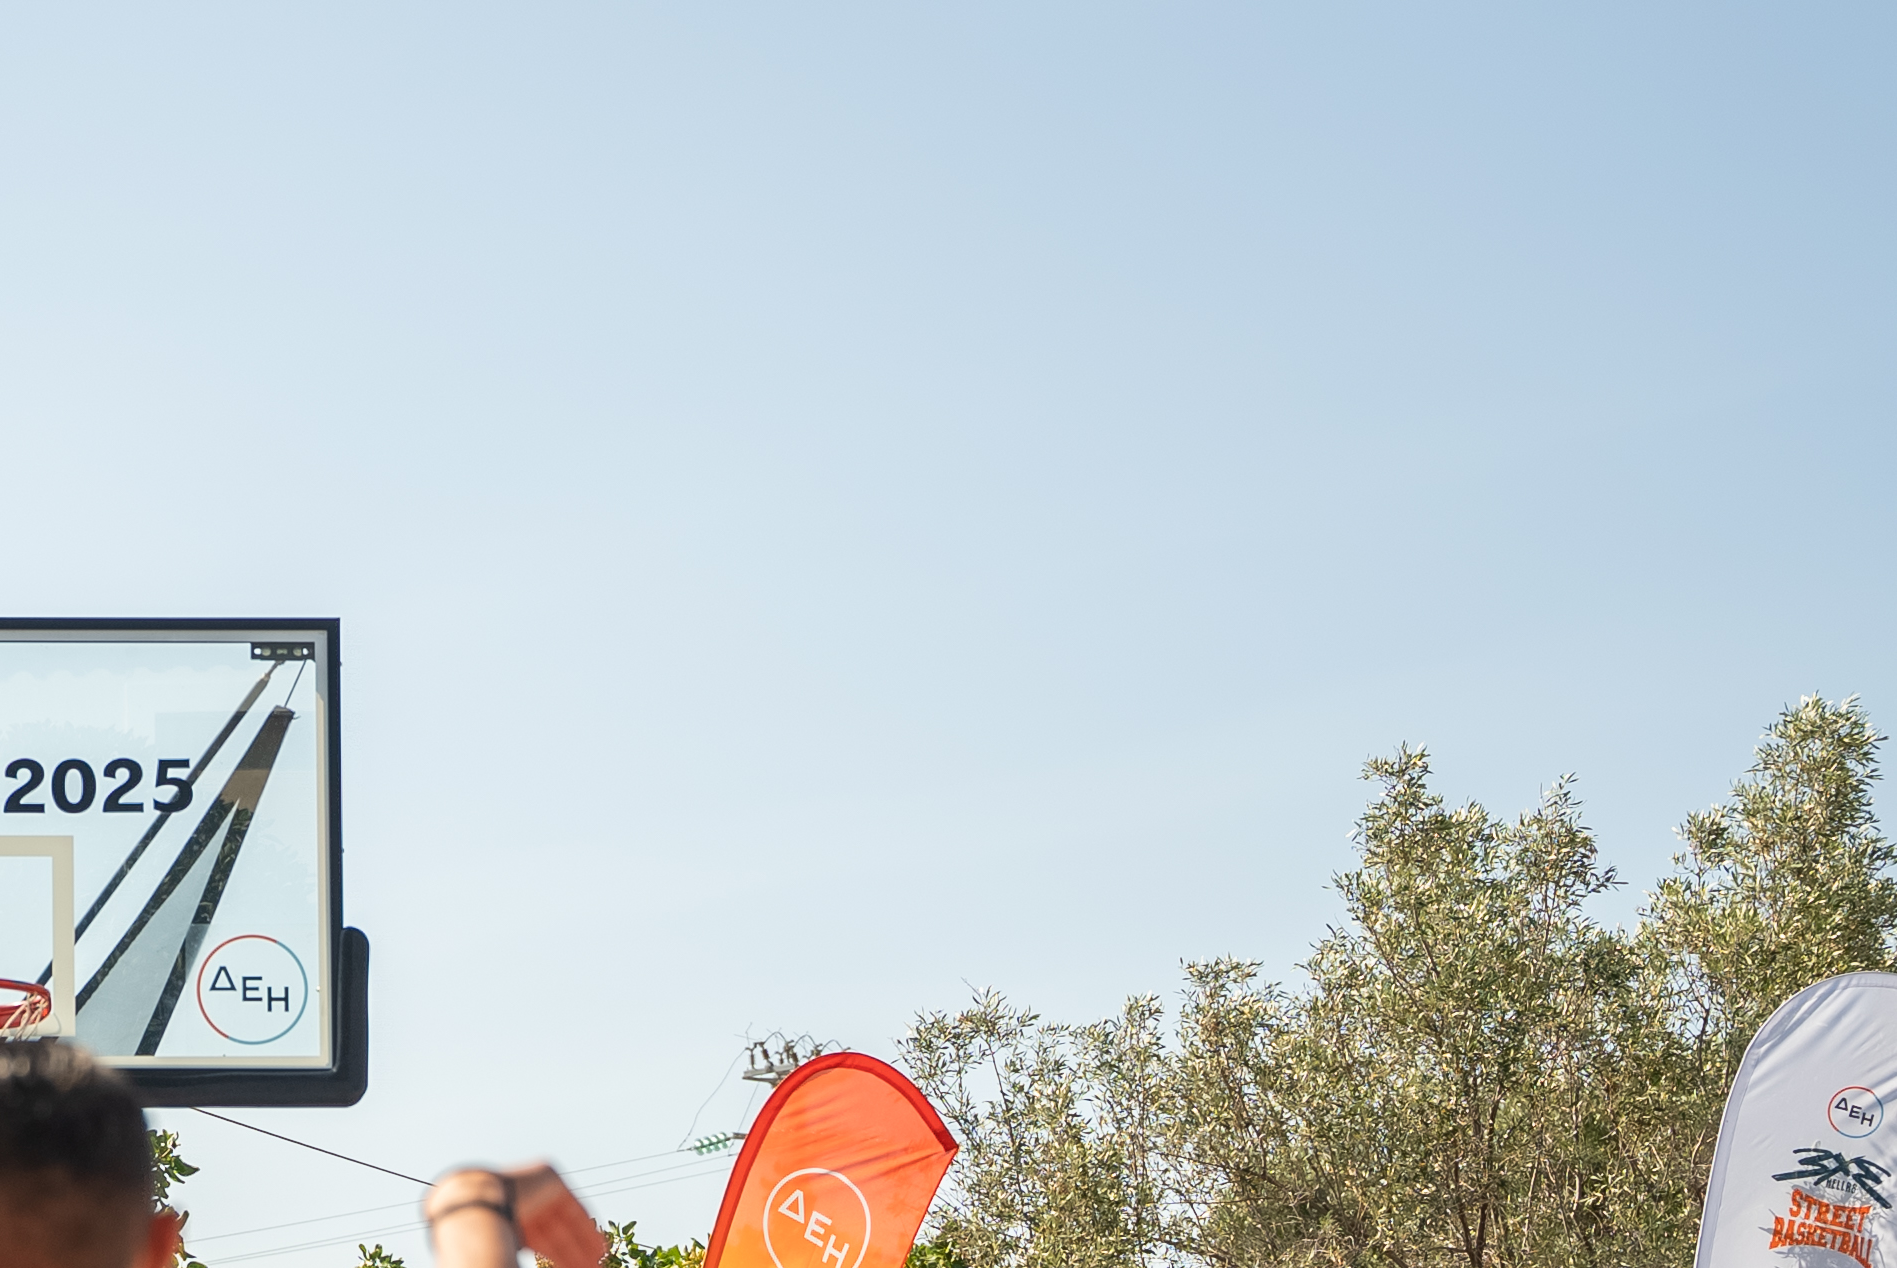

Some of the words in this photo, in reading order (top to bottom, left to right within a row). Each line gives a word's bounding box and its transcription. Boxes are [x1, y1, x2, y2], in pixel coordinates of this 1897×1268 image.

[3, 758, 194, 815] 2025
[209, 966, 290, 1013] ΔΕΗ
[1834, 1097, 1874, 1127] ΔΕΗ
[1789, 1188, 1872, 1233] STREET
